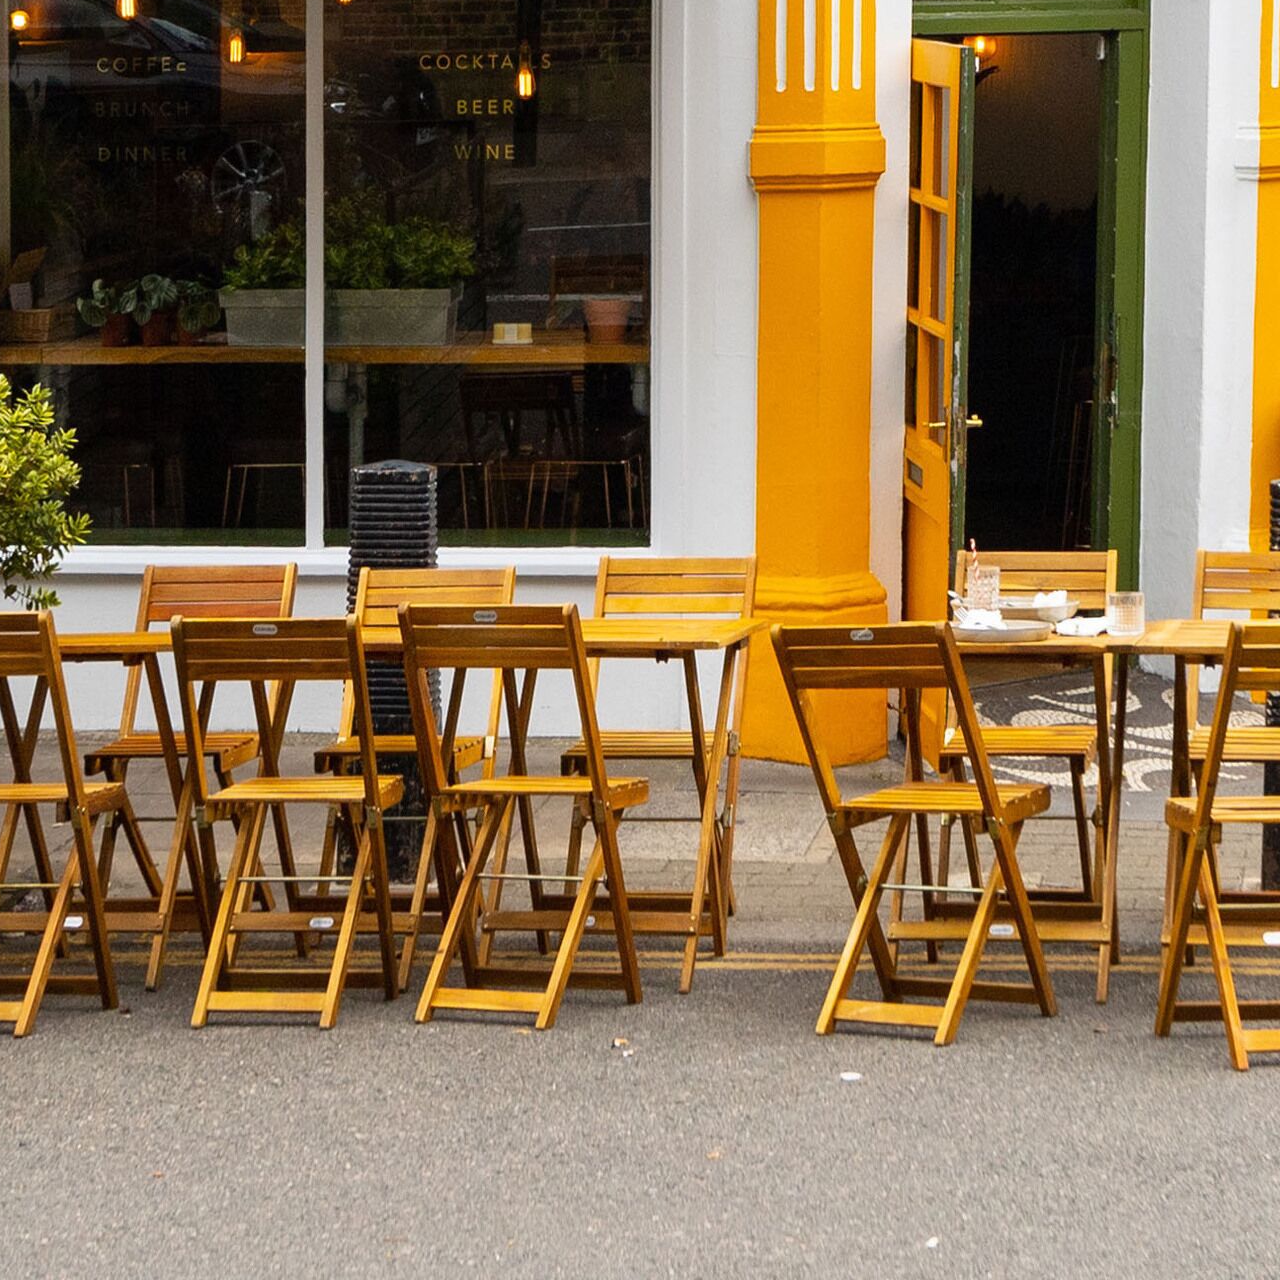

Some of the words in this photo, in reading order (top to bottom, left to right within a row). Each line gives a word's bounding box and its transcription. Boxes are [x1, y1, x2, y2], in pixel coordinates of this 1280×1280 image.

[96, 101, 189, 117] BRUNCH
[456, 99, 514, 115] BEER
[98, 146, 187, 162] DINNER
[454, 144, 515, 160] WINE
